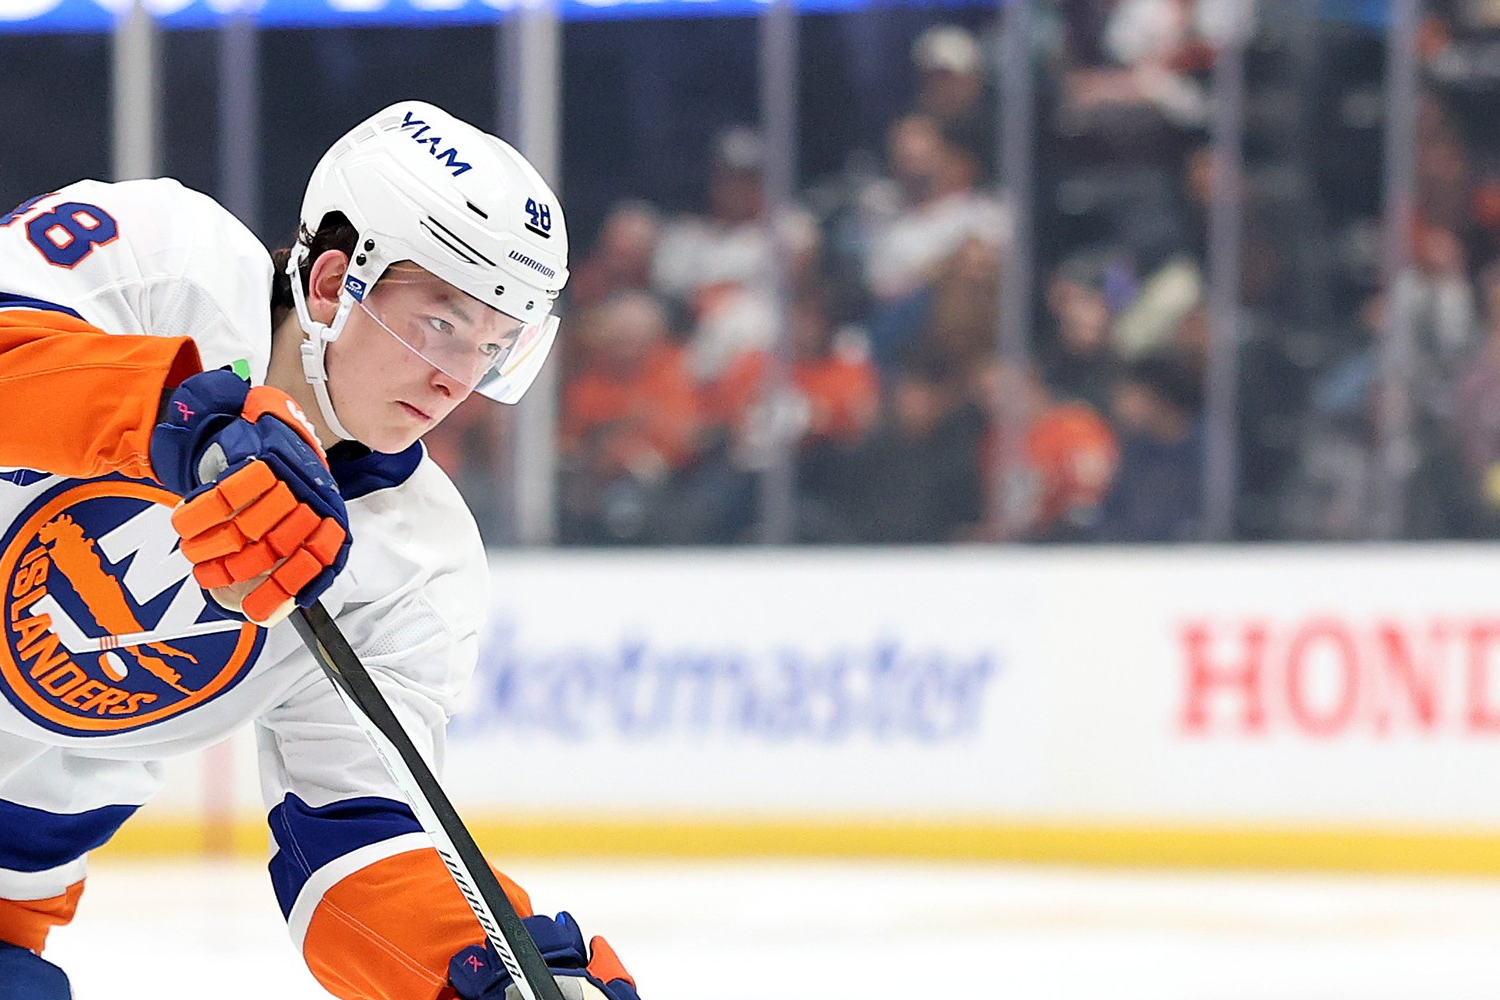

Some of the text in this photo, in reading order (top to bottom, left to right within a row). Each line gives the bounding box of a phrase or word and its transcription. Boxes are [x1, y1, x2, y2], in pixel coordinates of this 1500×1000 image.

[401, 111, 473, 177] VIAM
[524, 197, 552, 232] 48
[507, 250, 556, 279] WARRIOR
[10, 545, 158, 715] ISLANDERS
[446, 610, 1000, 742] ketmaster
[438, 849, 523, 980] WARRIOR
